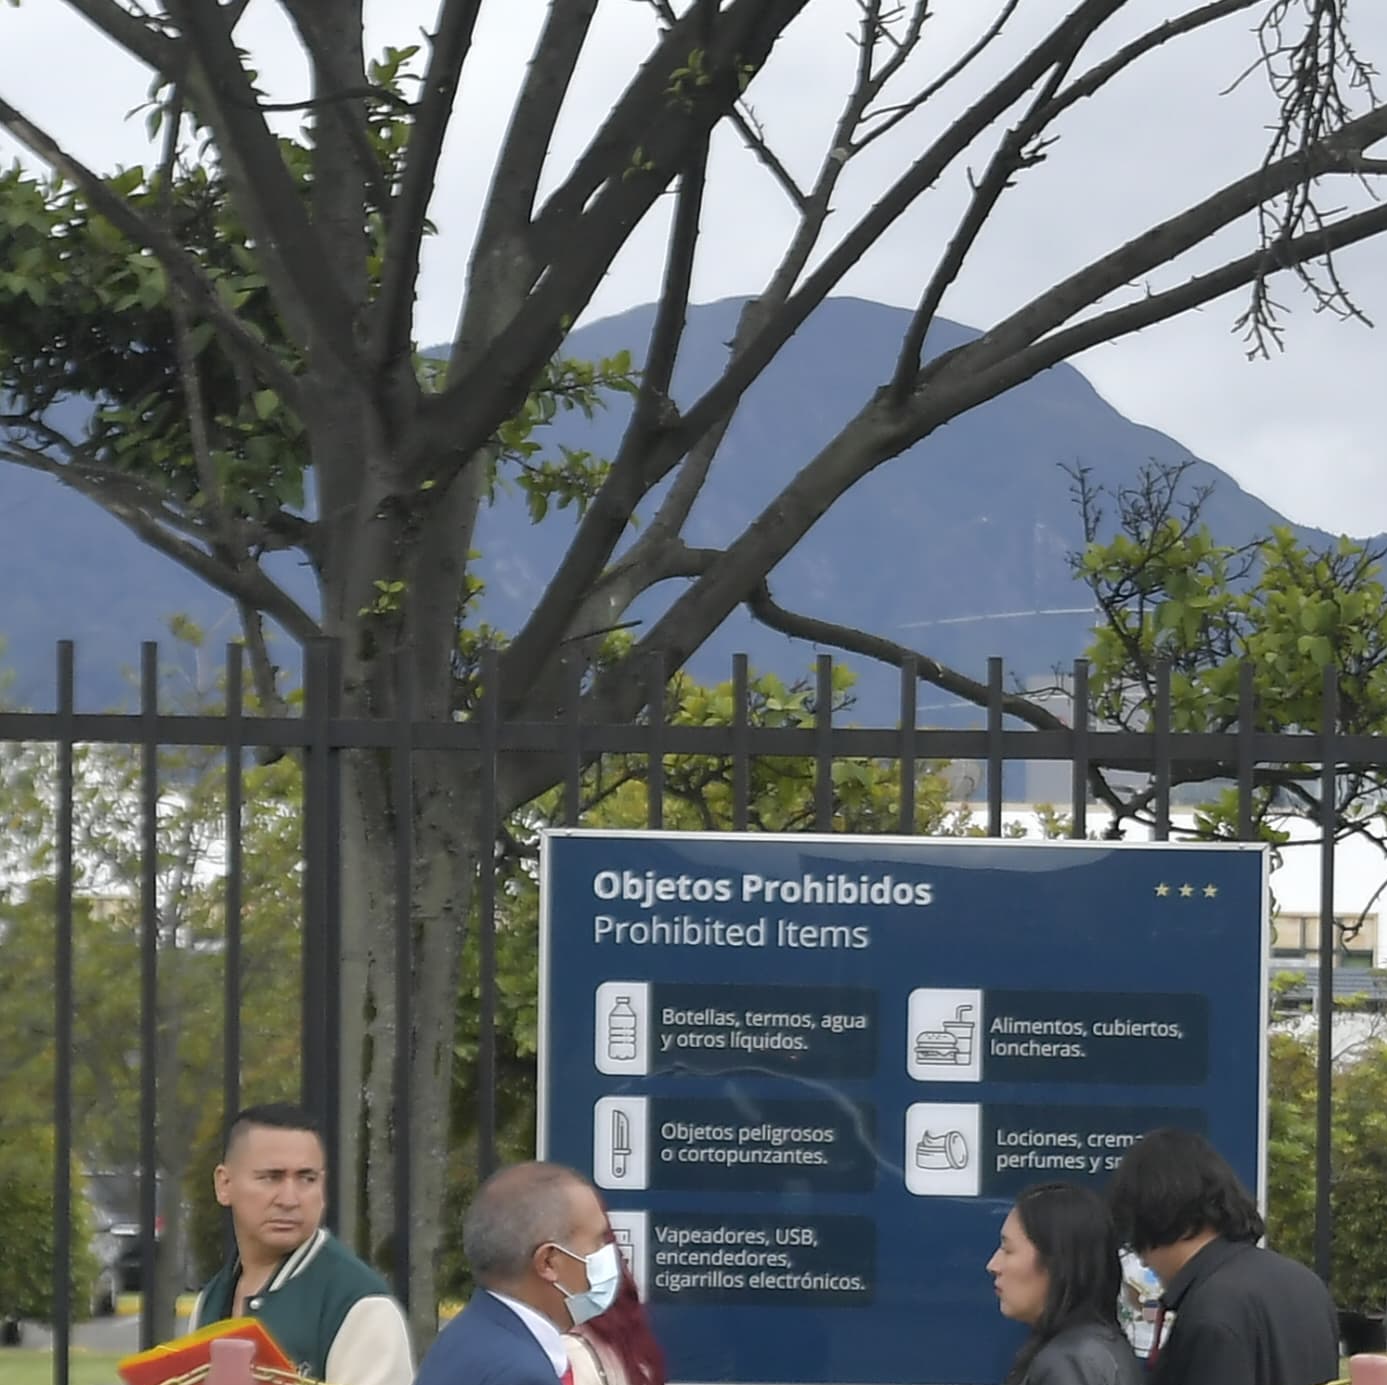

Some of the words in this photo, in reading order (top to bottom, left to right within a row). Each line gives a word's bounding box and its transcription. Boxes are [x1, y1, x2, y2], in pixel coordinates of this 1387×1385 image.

[593, 870, 732, 908] Objetos
[742, 874, 932, 905] Prohibidos
[595, 915, 766, 947] Prohibited
[778, 919, 869, 948] Items
[662, 1008, 741, 1028] Botellas,
[745, 1011, 816, 1030] termos,
[821, 1014, 867, 1033] agua
[989, 1016, 1087, 1037] Alimentos,
[1092, 1019, 1183, 1039] cubiertos,
[660, 1034, 673, 1052] y
[676, 1032, 726, 1048] otros
[730, 1029, 810, 1053] líquidos.
[990, 1039, 1086, 1058] loncheras.
[661, 1122, 734, 1145] Objetos
[738, 1124, 835, 1146] peligrosos
[997, 1129, 1083, 1149] Lociones,
[1087, 1133, 1144, 1148] crem
[660, 1148, 674, 1162] o
[678, 1146, 828, 1167] cortopunzantes.
[996, 1151, 1086, 1172] perfumes
[1088, 1156, 1102, 1174] y
[654, 1226, 770, 1246] Vapeadores,
[775, 1228, 818, 1247] USB,
[655, 1249, 792, 1269] encendedores,
[655, 1270, 745, 1292] cigarrillos
[748, 1271, 866, 1290] electrónicos.
